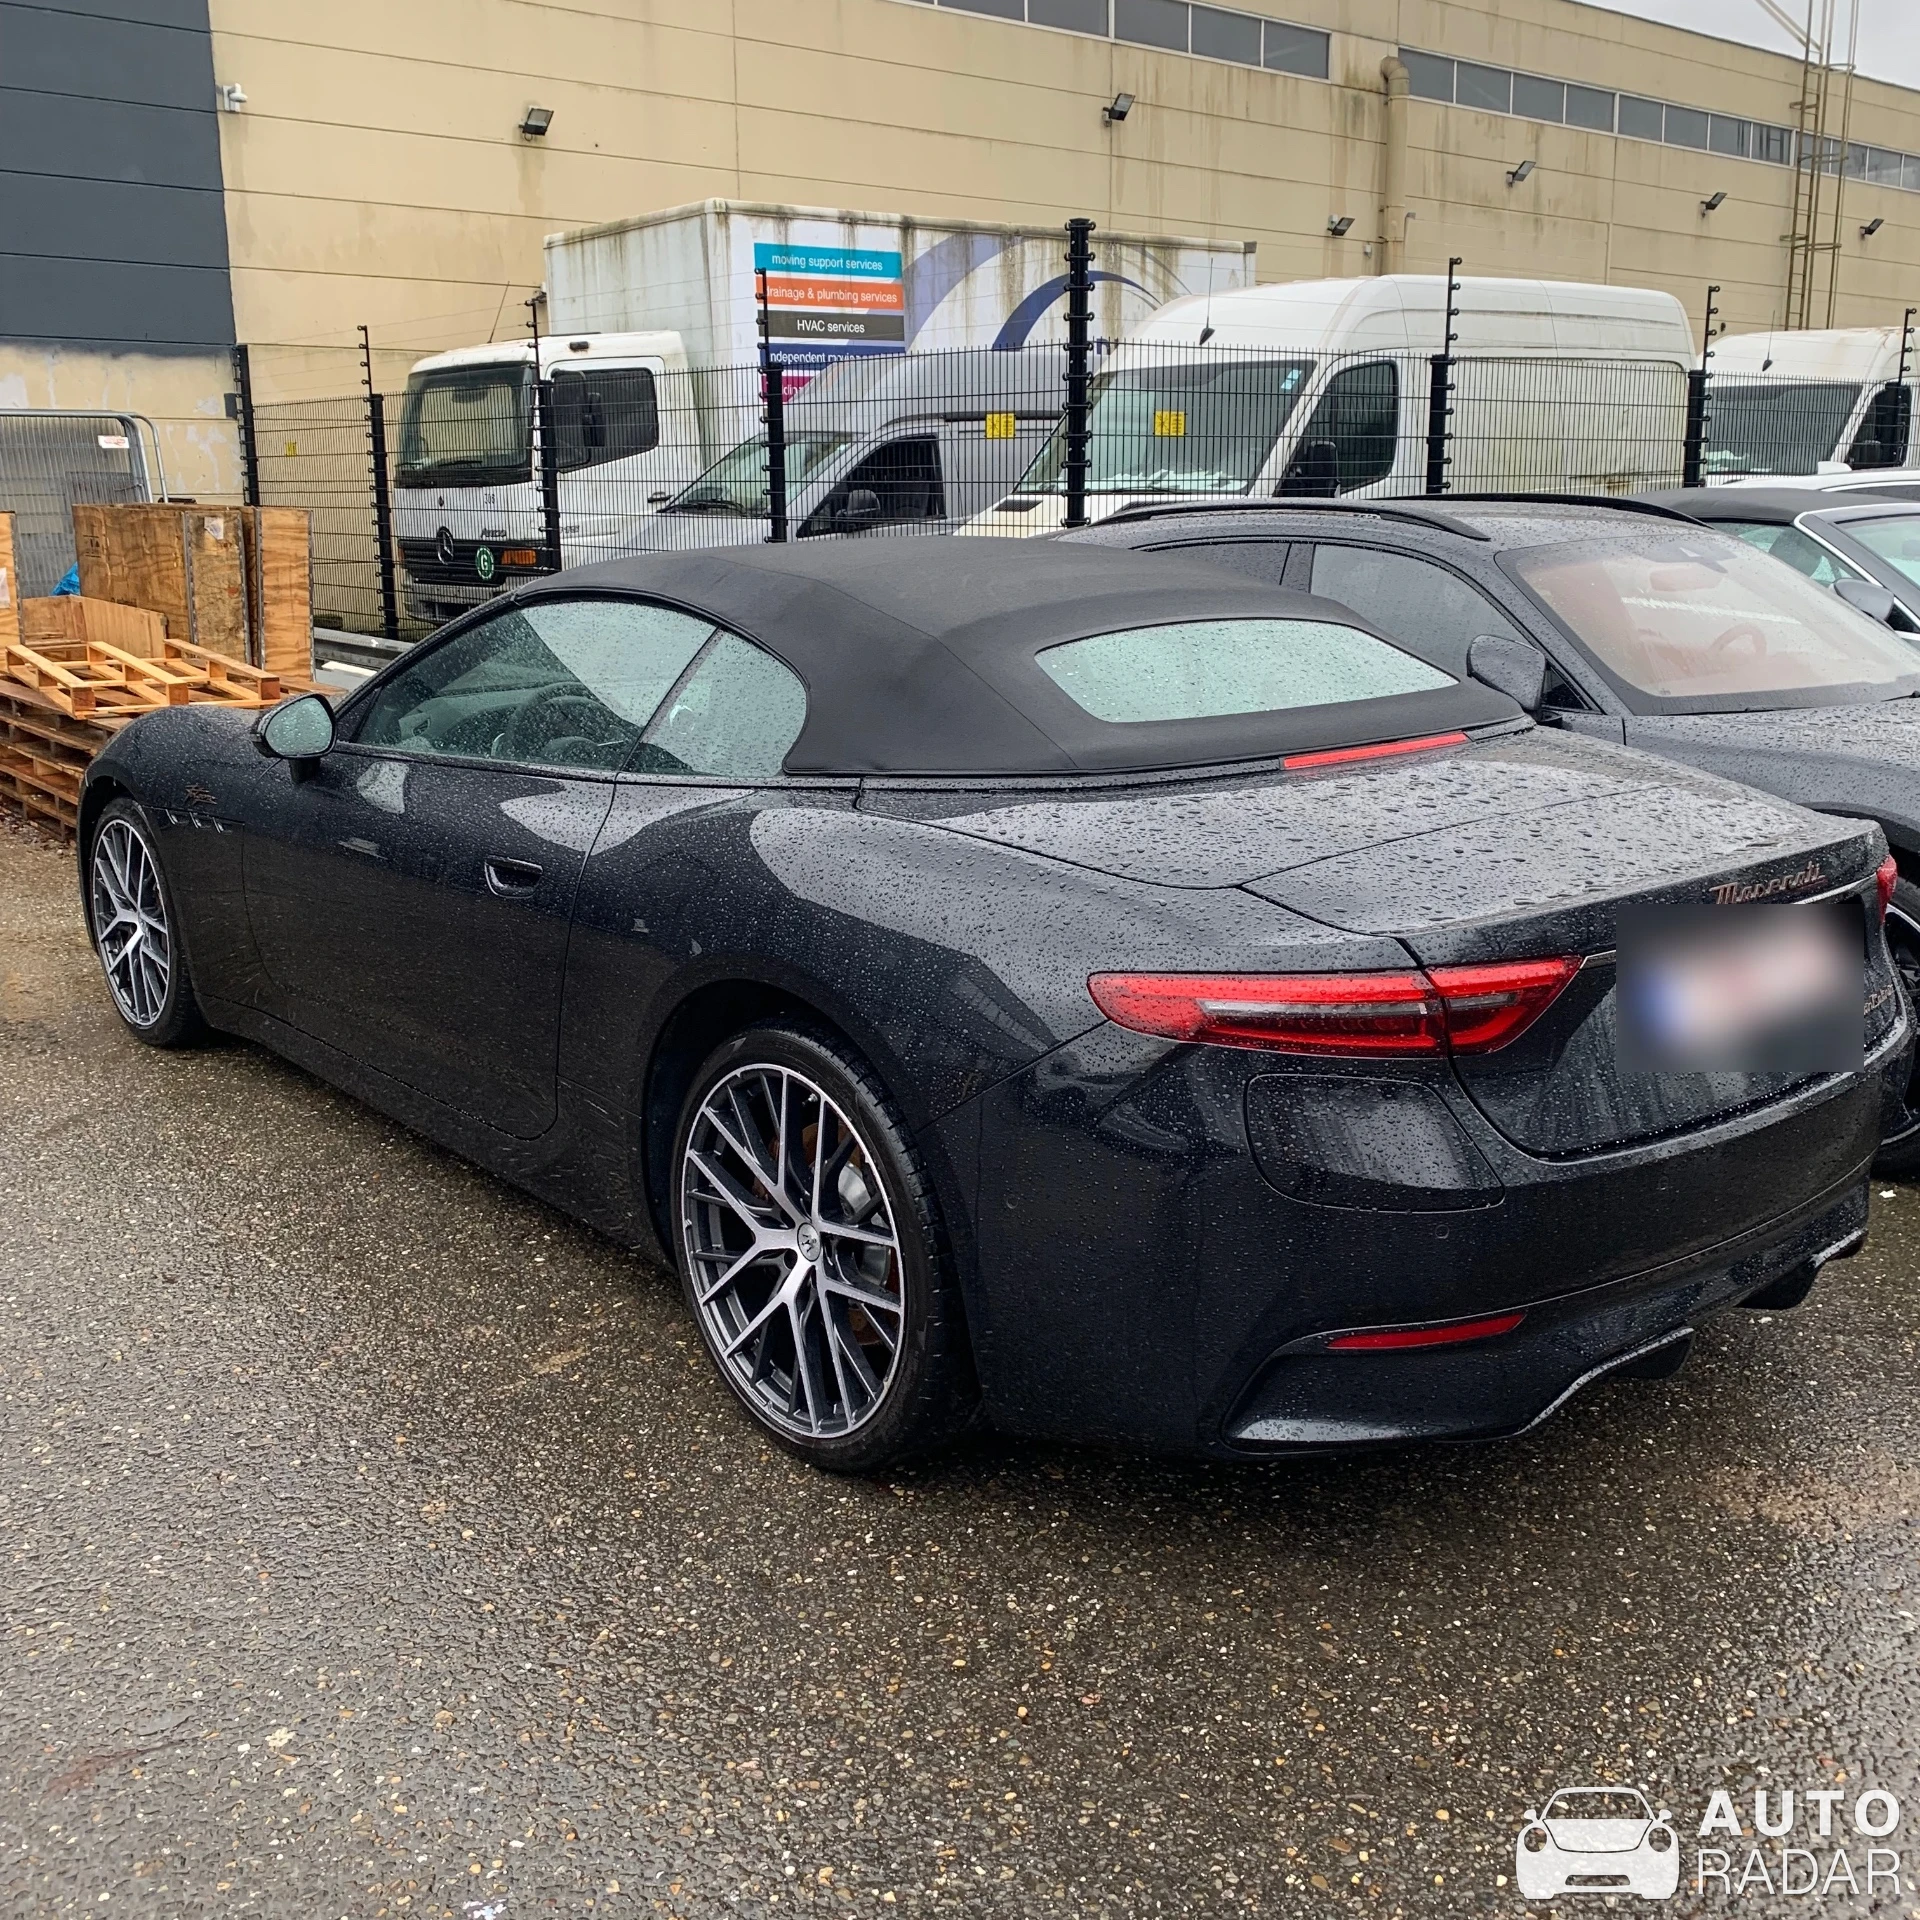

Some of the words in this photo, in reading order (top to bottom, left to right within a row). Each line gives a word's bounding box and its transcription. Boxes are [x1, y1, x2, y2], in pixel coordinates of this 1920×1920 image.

[772, 254, 806, 269] moving
[808, 256, 843, 270] support
[846, 258, 883, 271] services
[807, 288, 815, 299] &
[817, 288, 859, 303] plumbing
[861, 291, 898, 303] services
[797, 319, 825, 332] HVAC
[827, 320, 865, 333] services
[770, 351, 826, 365] ndependent
